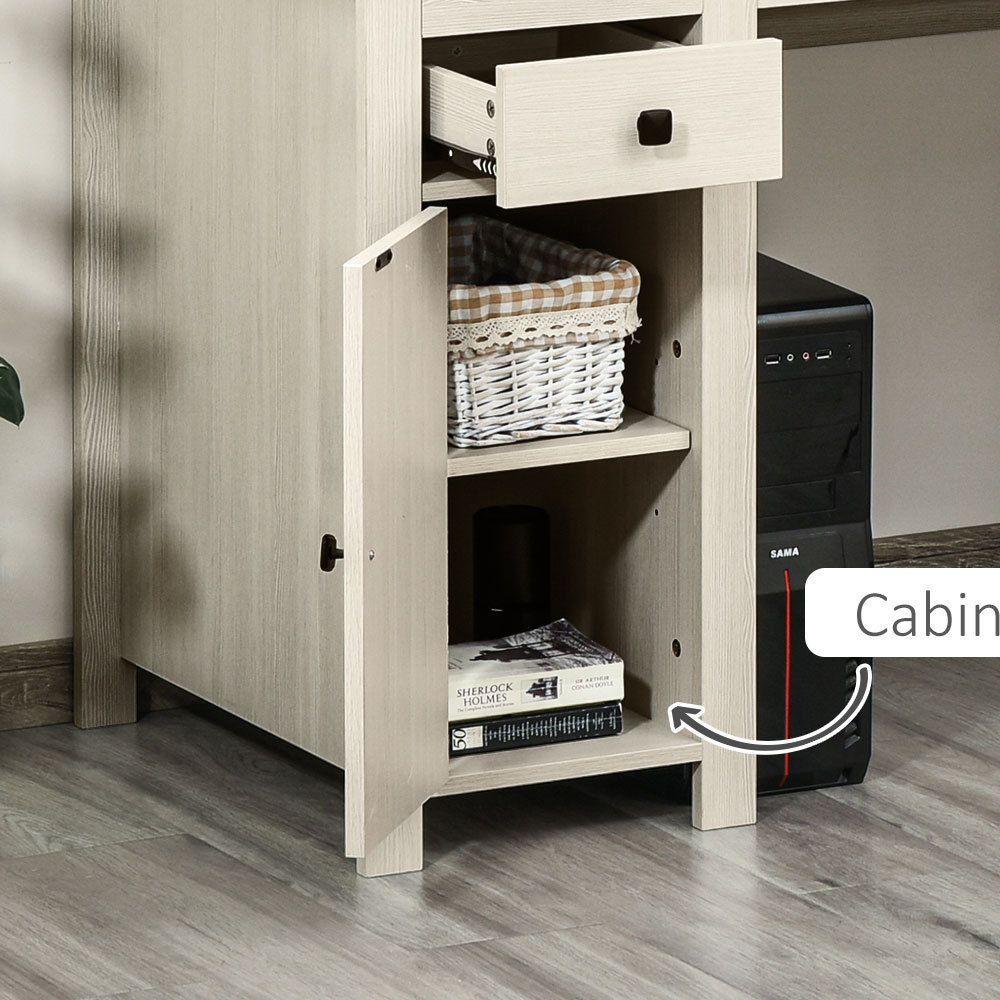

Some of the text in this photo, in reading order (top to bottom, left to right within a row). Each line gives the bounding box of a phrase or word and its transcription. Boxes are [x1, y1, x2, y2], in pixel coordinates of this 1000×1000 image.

[770, 546, 800, 559] SAMA
[456, 682, 513, 698] SHERLOCK
[463, 693, 508, 707] HOLMES
[452, 728, 467, 750] 50
